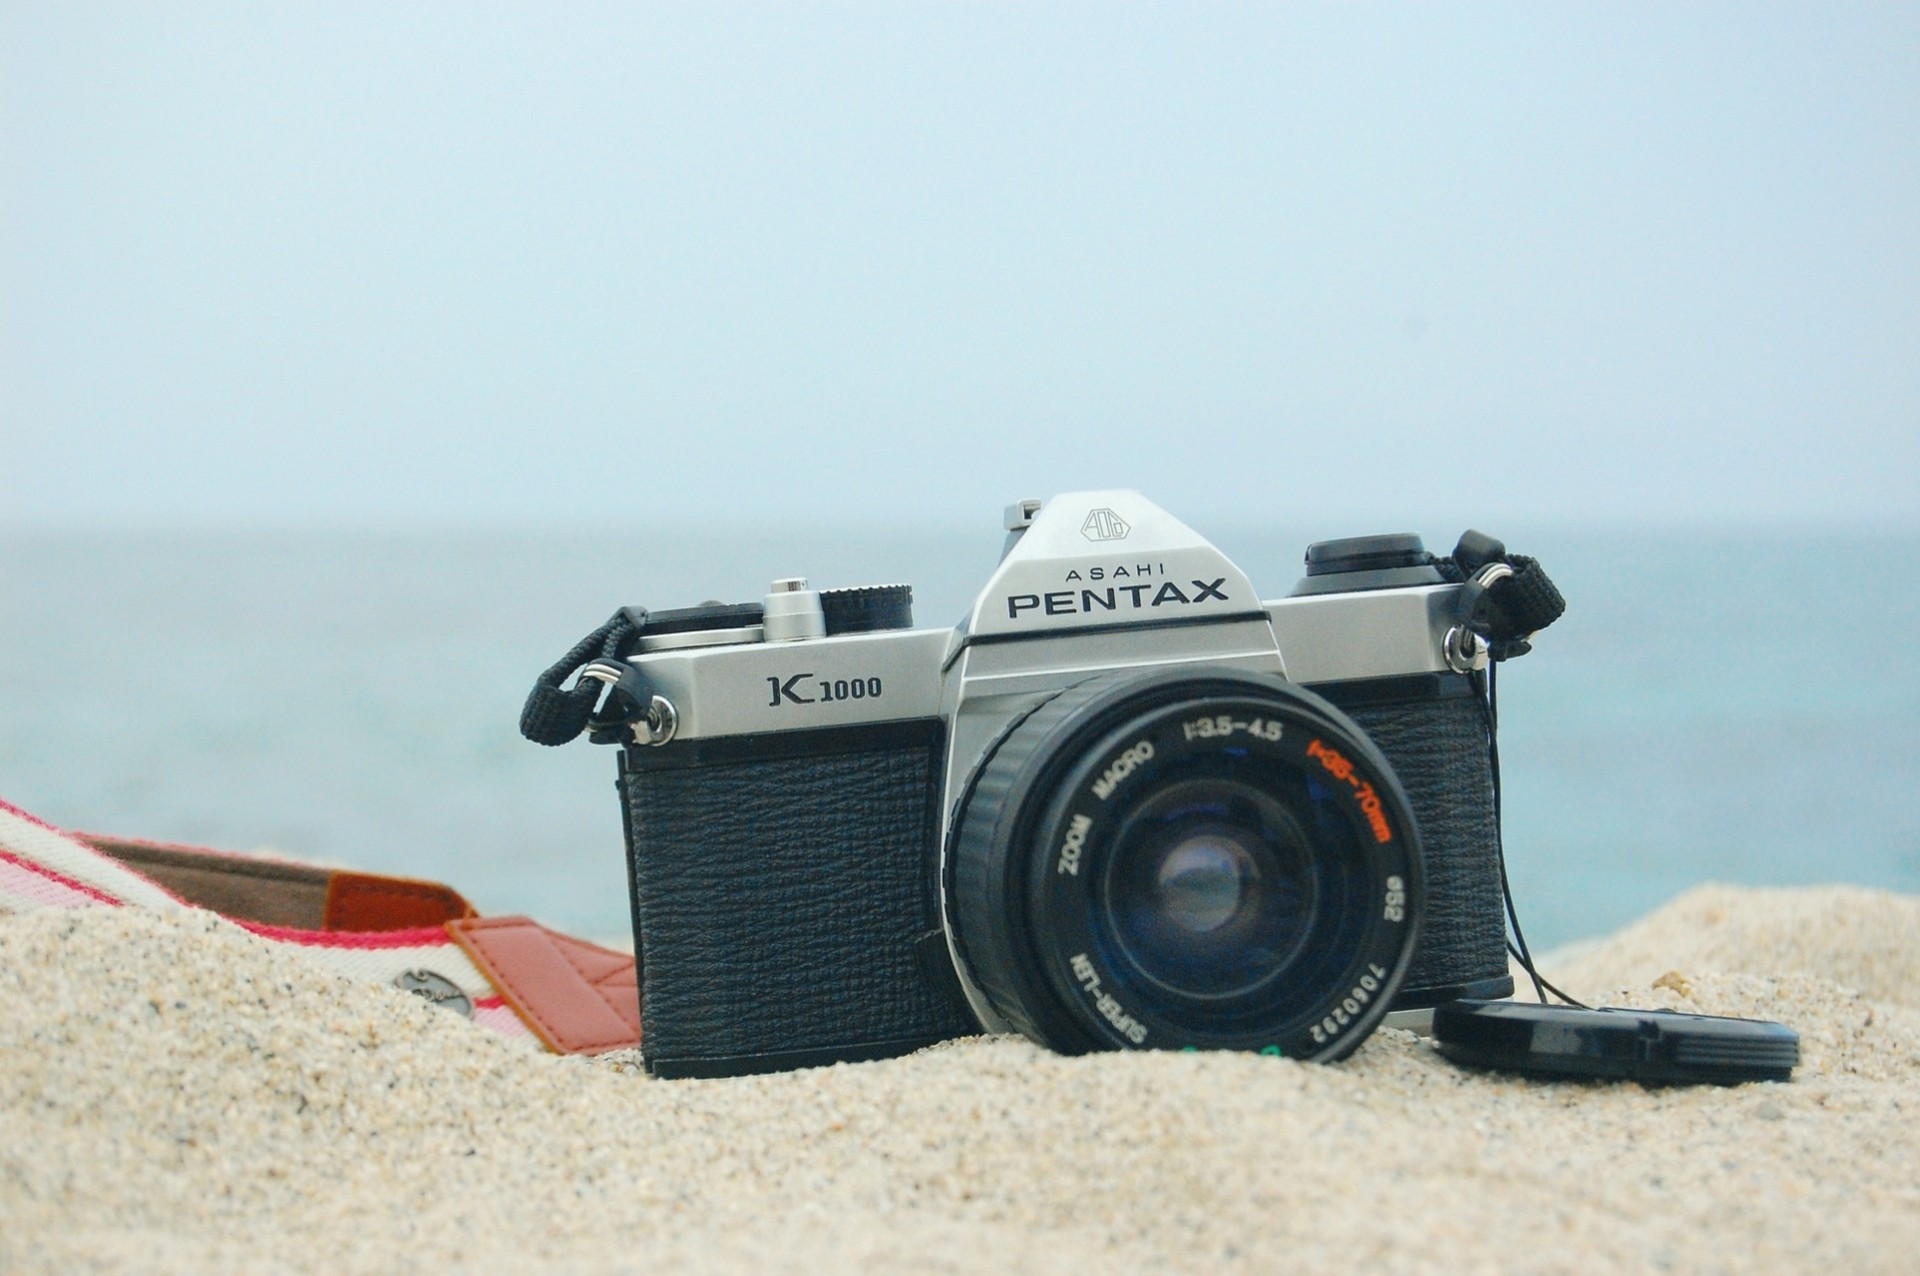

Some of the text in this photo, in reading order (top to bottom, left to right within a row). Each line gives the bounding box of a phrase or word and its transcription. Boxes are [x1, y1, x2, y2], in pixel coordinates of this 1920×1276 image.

[1065, 562, 1164, 583] ASAHI
[1007, 577, 1229, 619] PENTAX
[1057, 813, 1093, 876] ZOOM
[1091, 740, 1155, 800] MACRO
